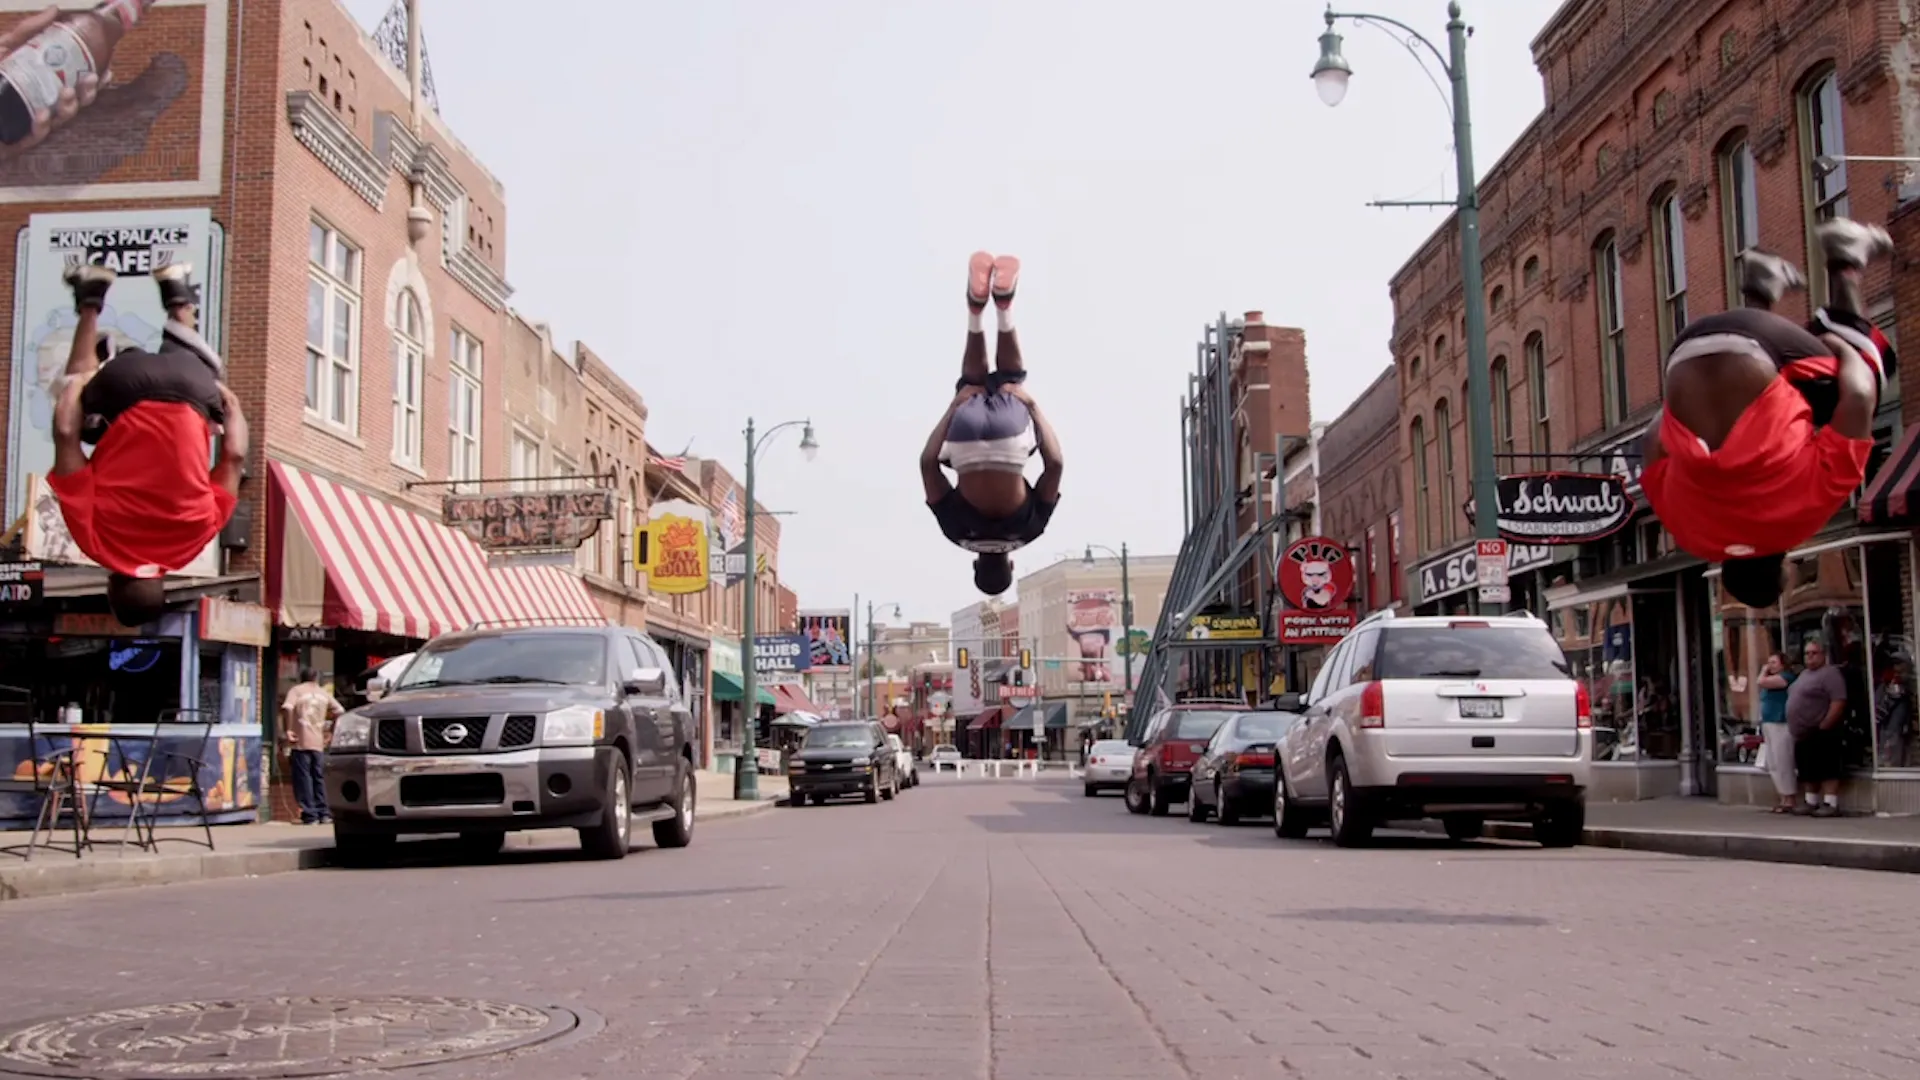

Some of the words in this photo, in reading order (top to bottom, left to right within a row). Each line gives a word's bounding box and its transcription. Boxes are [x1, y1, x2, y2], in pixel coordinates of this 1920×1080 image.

[118, 227, 181, 246] PALACE
[1513, 480, 1622, 515] Schwab
[485, 518, 573, 545] CAFE
[1288, 542, 1345, 563] PIG
[1481, 542, 1501, 554] NO
[11, 562, 42, 571] PALACE
[654, 559, 701, 577] ROOM
[0, 584, 32, 601] ATIO
[1284, 616, 1317, 625] PORK
[1320, 615, 1350, 625] WITH
[290, 629, 325, 640] ATM
[1284, 627, 1299, 637] AN
[755, 657, 795, 671] HALL
